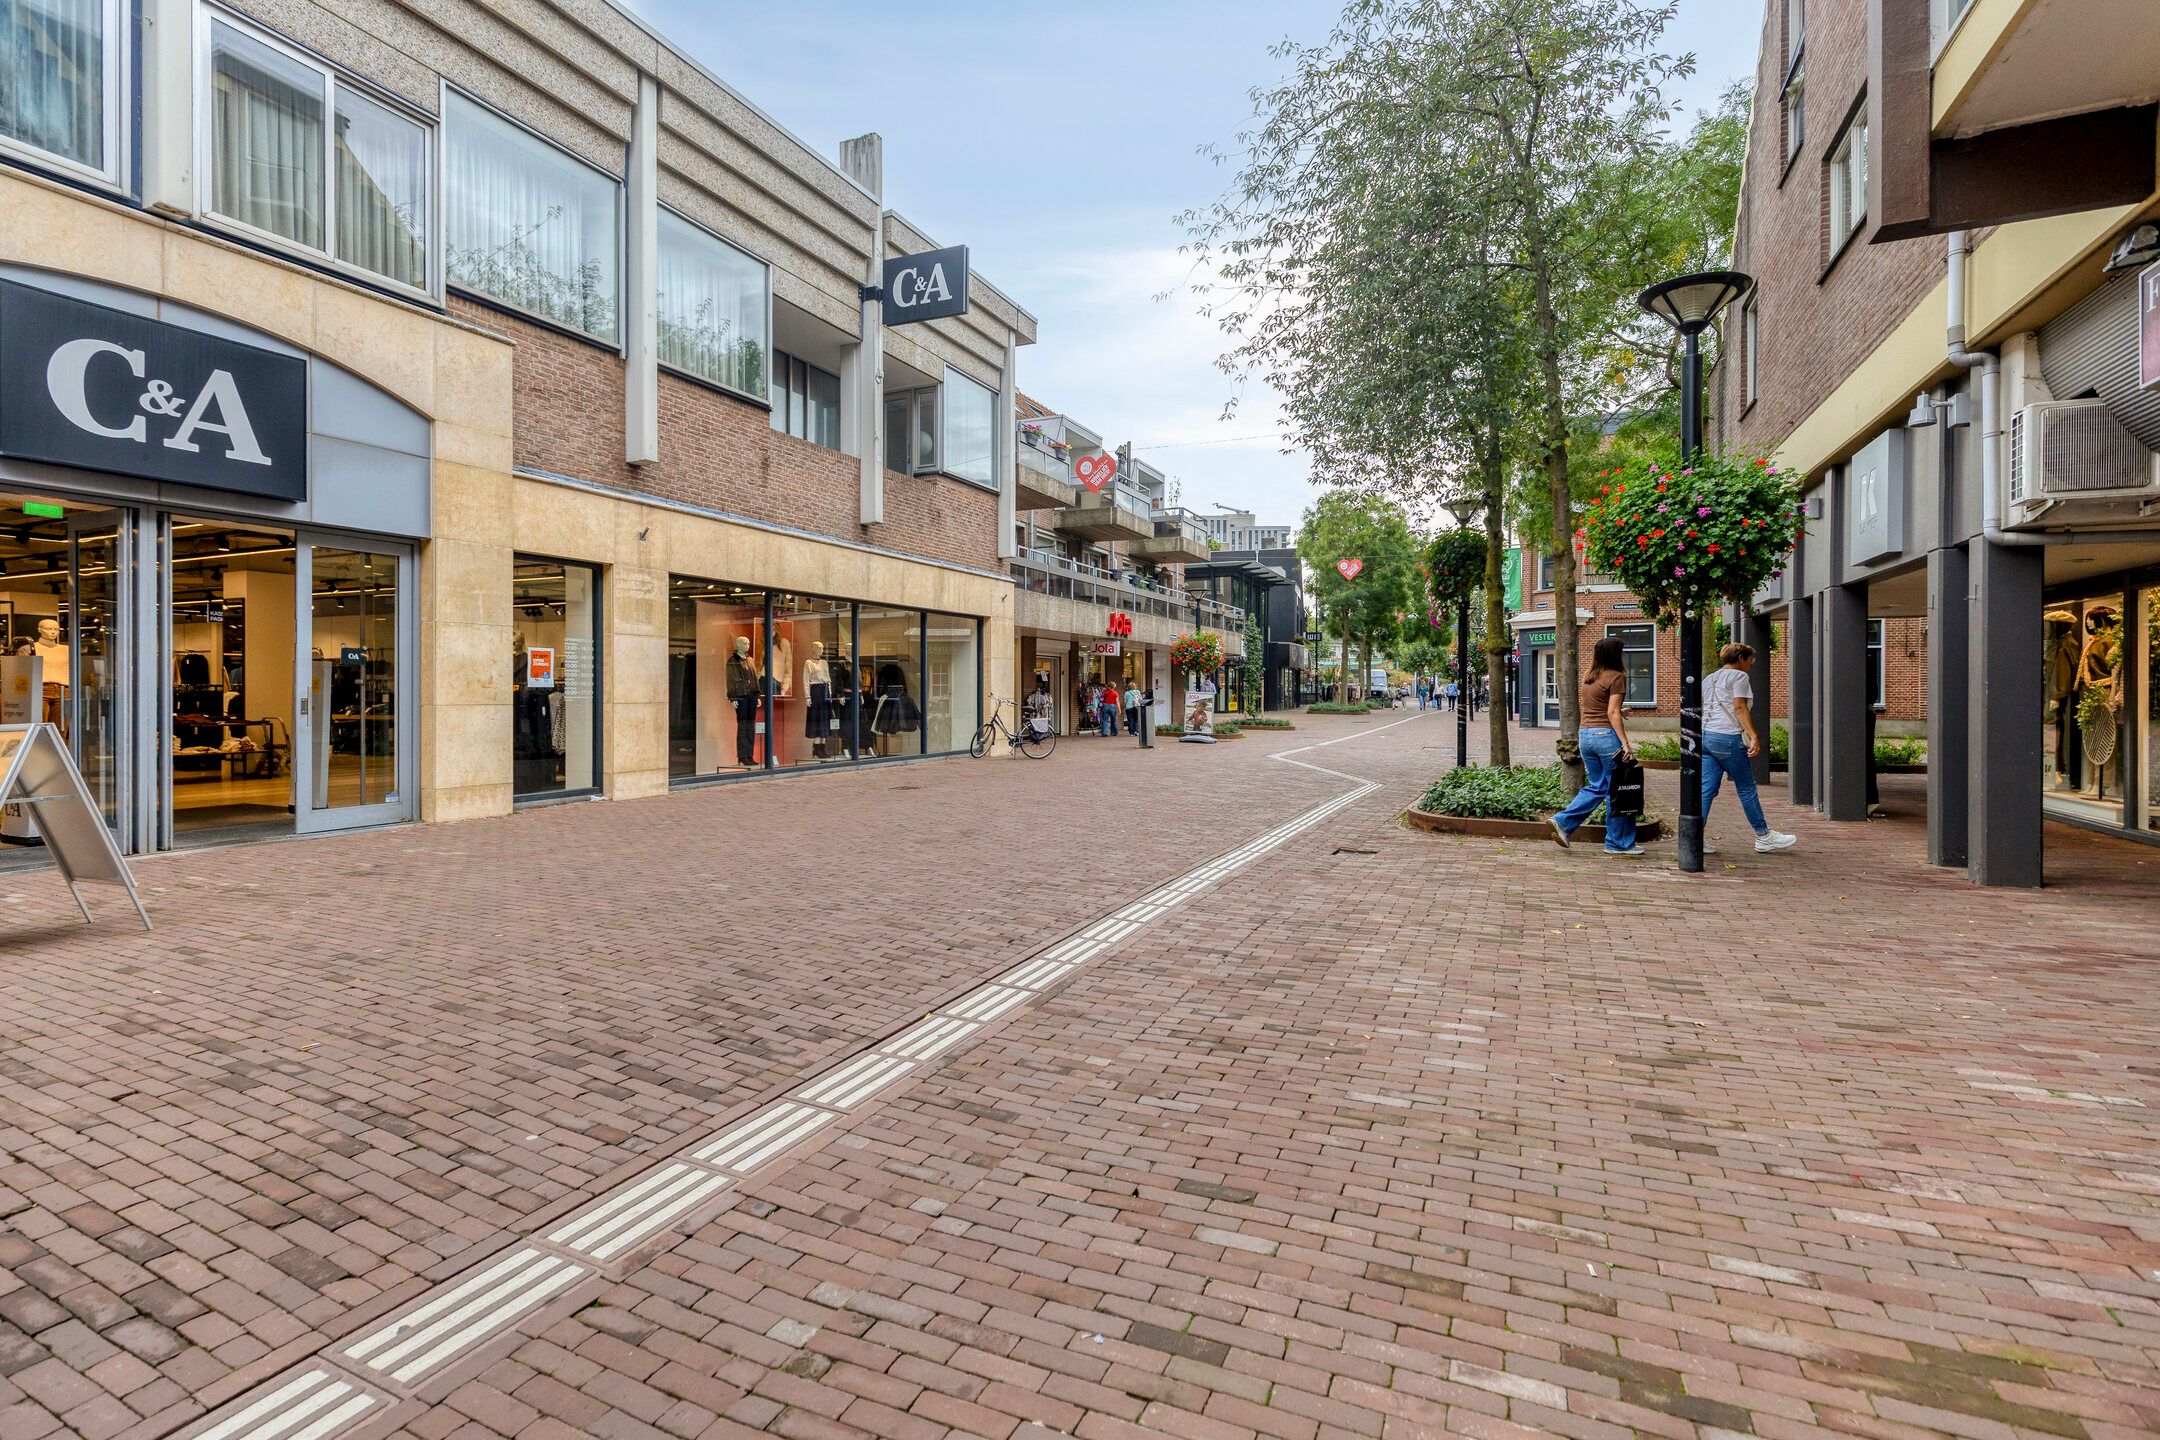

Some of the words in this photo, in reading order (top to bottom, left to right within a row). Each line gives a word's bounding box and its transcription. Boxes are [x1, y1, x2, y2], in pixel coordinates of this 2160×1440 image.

[892, 263, 953, 308] C&A
[47, 338, 272, 466] C&A
[1106, 609, 1132, 636] Jola
[1092, 643, 1115, 653] Jola
